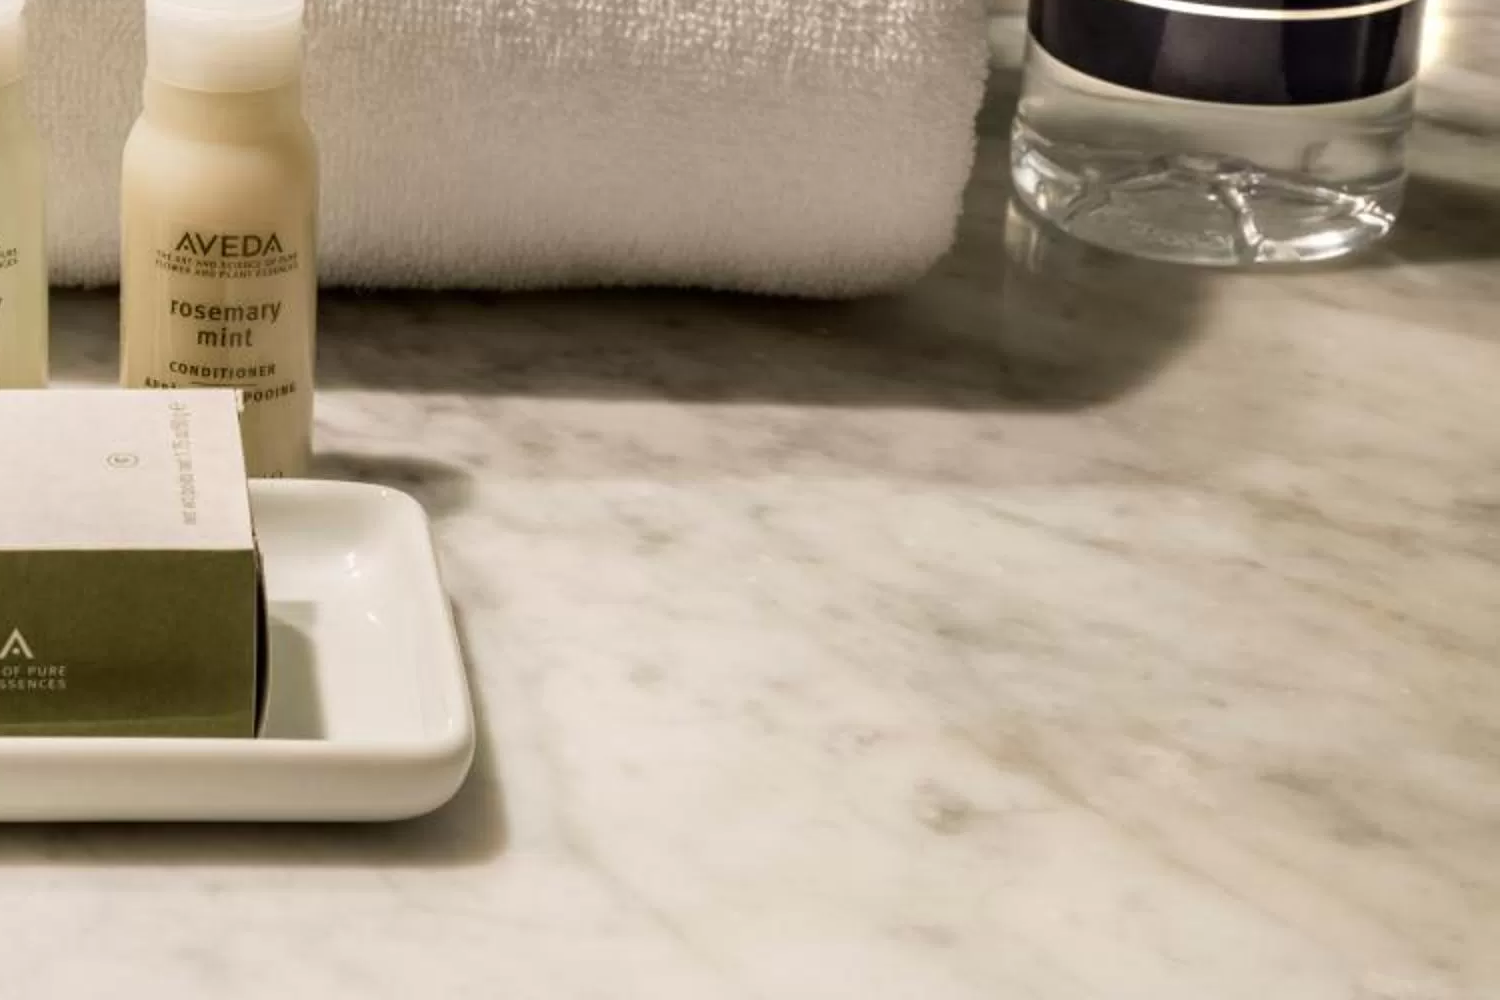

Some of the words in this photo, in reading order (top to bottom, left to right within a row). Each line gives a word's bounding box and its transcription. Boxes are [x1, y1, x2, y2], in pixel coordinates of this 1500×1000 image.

[175, 232, 284, 258] AVEDA
[169, 299, 282, 324] rosemary
[196, 327, 252, 348] mint
[168, 360, 276, 380] CONDITIONER
[2, 666, 20, 677] OF
[28, 666, 67, 677] PURE
